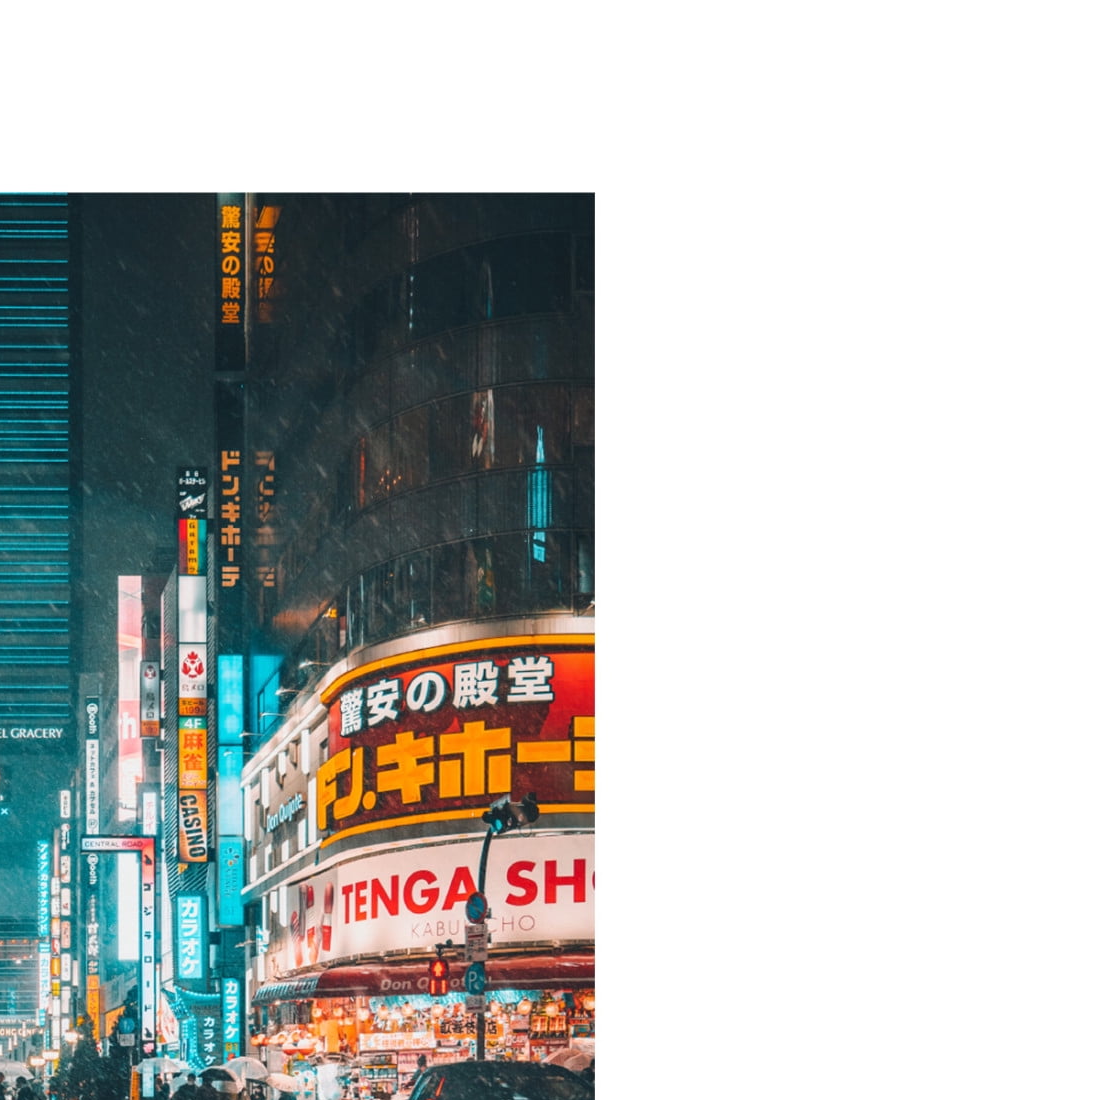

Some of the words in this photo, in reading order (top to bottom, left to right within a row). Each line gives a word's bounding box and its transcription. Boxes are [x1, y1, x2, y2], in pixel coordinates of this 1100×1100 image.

[221, 205, 241, 324] 驚安の殿堂
[340, 655, 554, 736] 驚安の殿堂
[10, 727, 64, 739] GRACERY
[184, 717, 202, 729] 4F
[183, 732, 204, 771] 麻雀
[85, 840, 120, 848] CENTRAL
[122, 840, 144, 848] ROAD
[180, 794, 206, 859] CASINO
[341, 866, 478, 925] TENGA
[504, 858, 595, 907] SH
[143, 881, 154, 1012] ゴジラロード
[180, 899, 200, 975] カラオケ
[225, 980, 239, 1039] カラオケ
[380, 978, 412, 991] Don
[203, 1016, 217, 1066] カラオケ
[440, 1020, 498, 1035] 歌舞伎店
